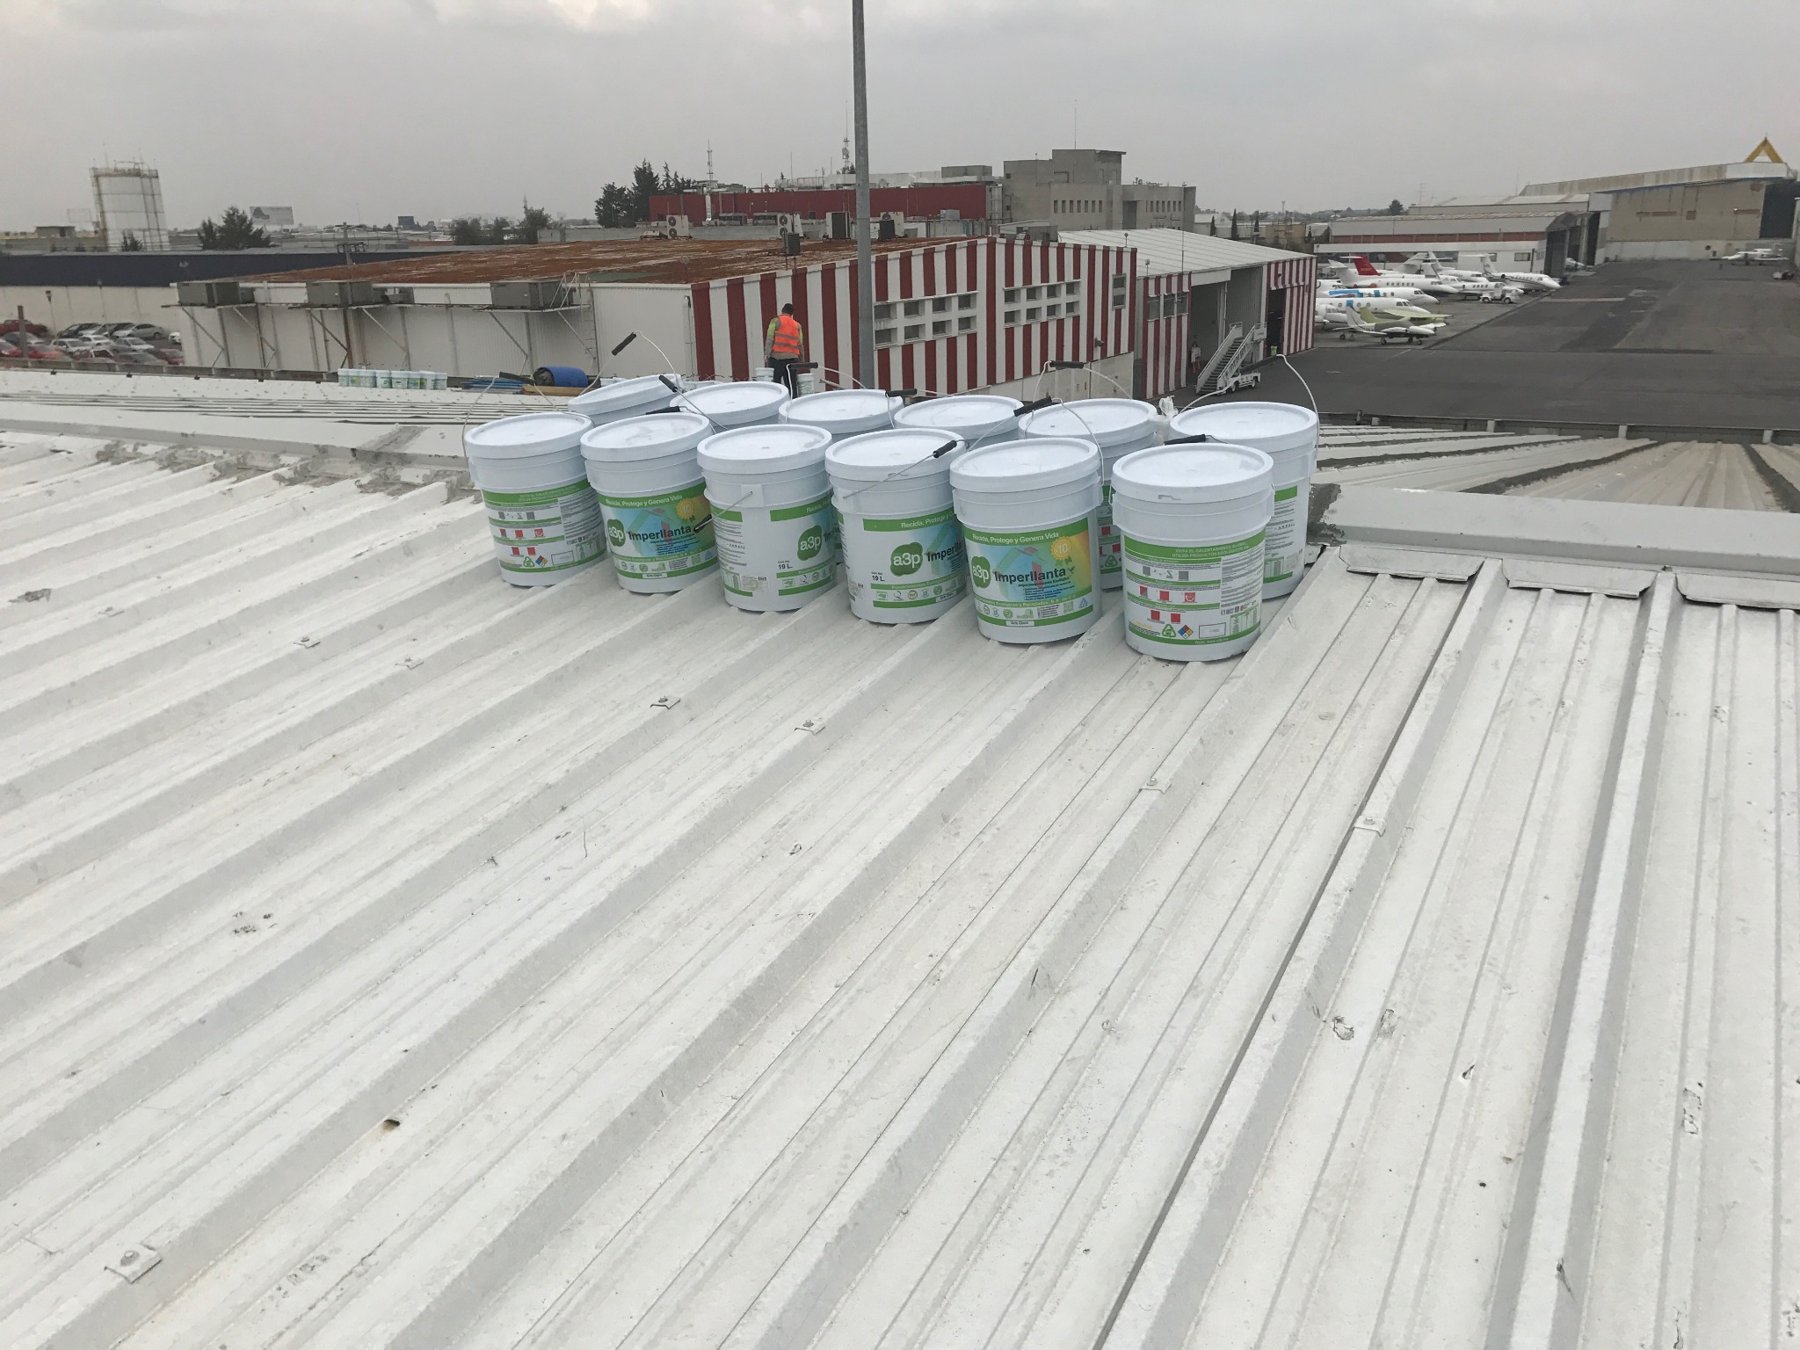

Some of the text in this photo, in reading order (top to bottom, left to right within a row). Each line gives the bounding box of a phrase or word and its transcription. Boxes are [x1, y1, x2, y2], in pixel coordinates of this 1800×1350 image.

[799, 536, 821, 551] a3p
[893, 552, 920, 568] a3p
[972, 564, 989, 583] a3p
[993, 567, 1066, 584] Imperllanta
